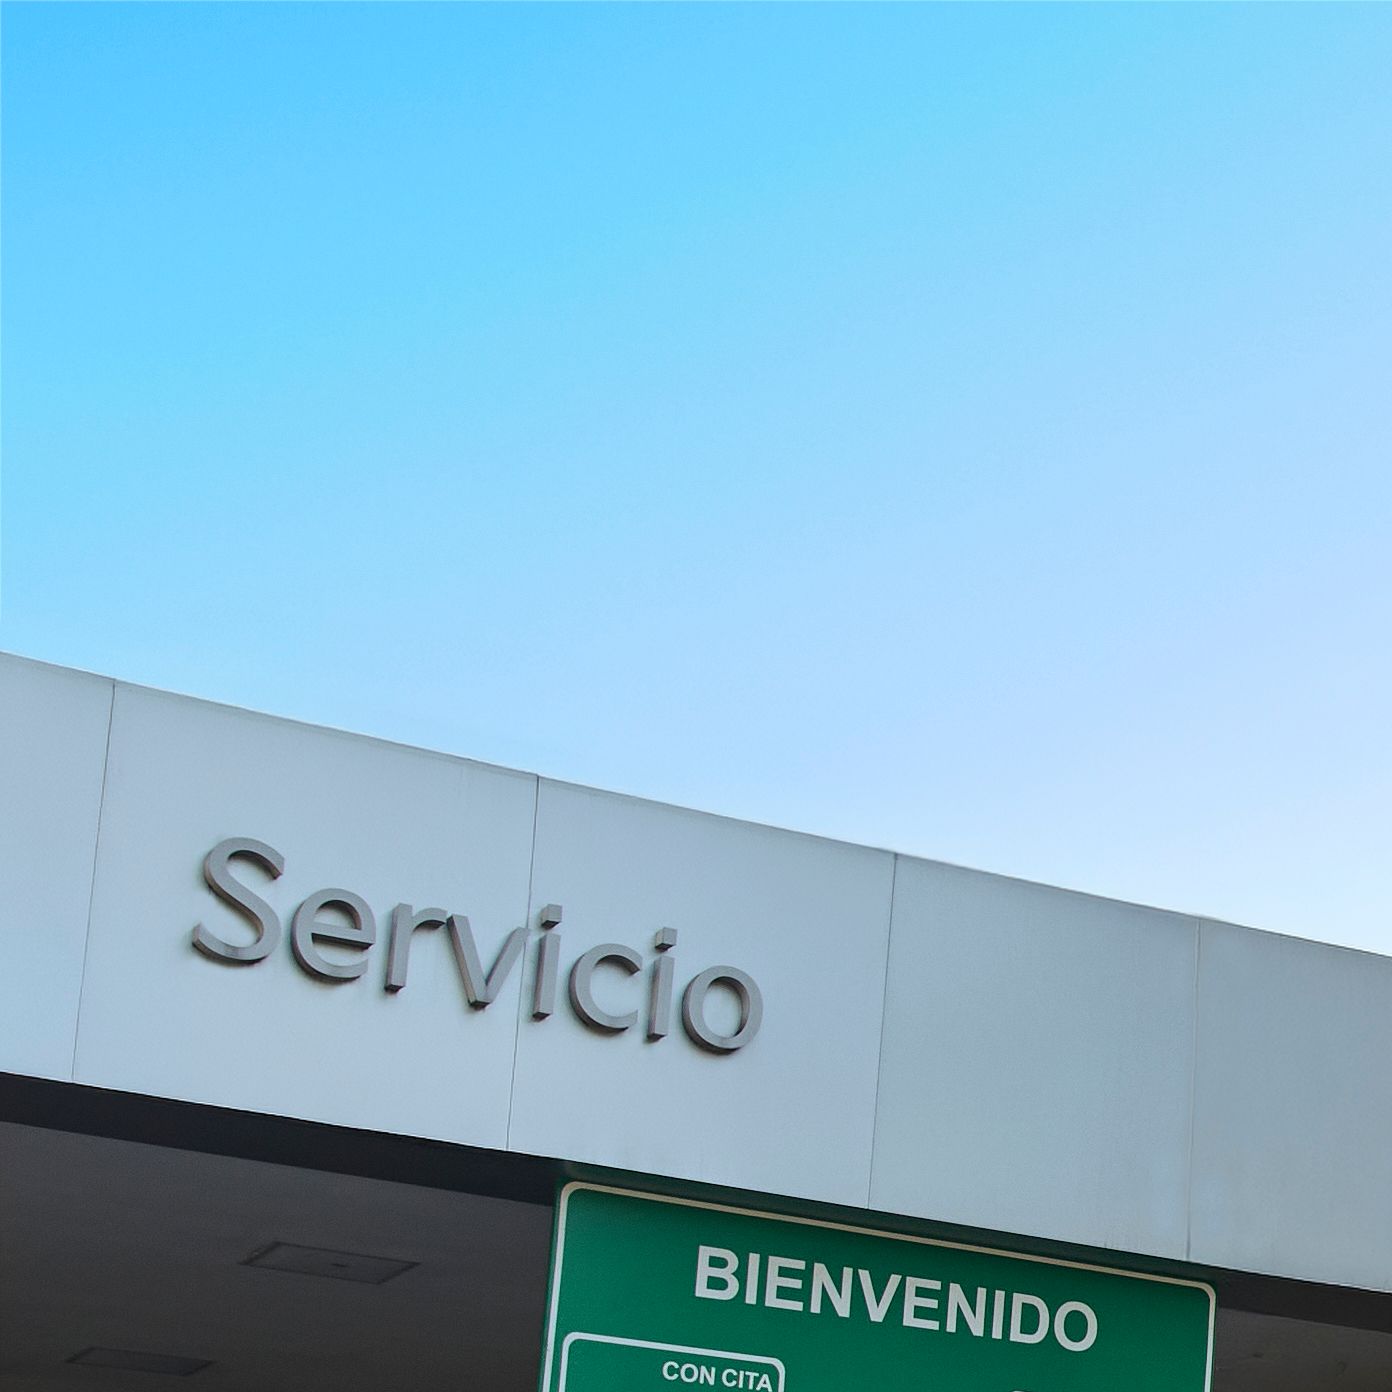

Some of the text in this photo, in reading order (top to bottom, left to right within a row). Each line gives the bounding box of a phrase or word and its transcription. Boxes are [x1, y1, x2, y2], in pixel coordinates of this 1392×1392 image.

[191, 836, 764, 1054] Servicio
[694, 1244, 1098, 1352] BIENVENIDO
[662, 1361, 773, 1392] CON CITA
